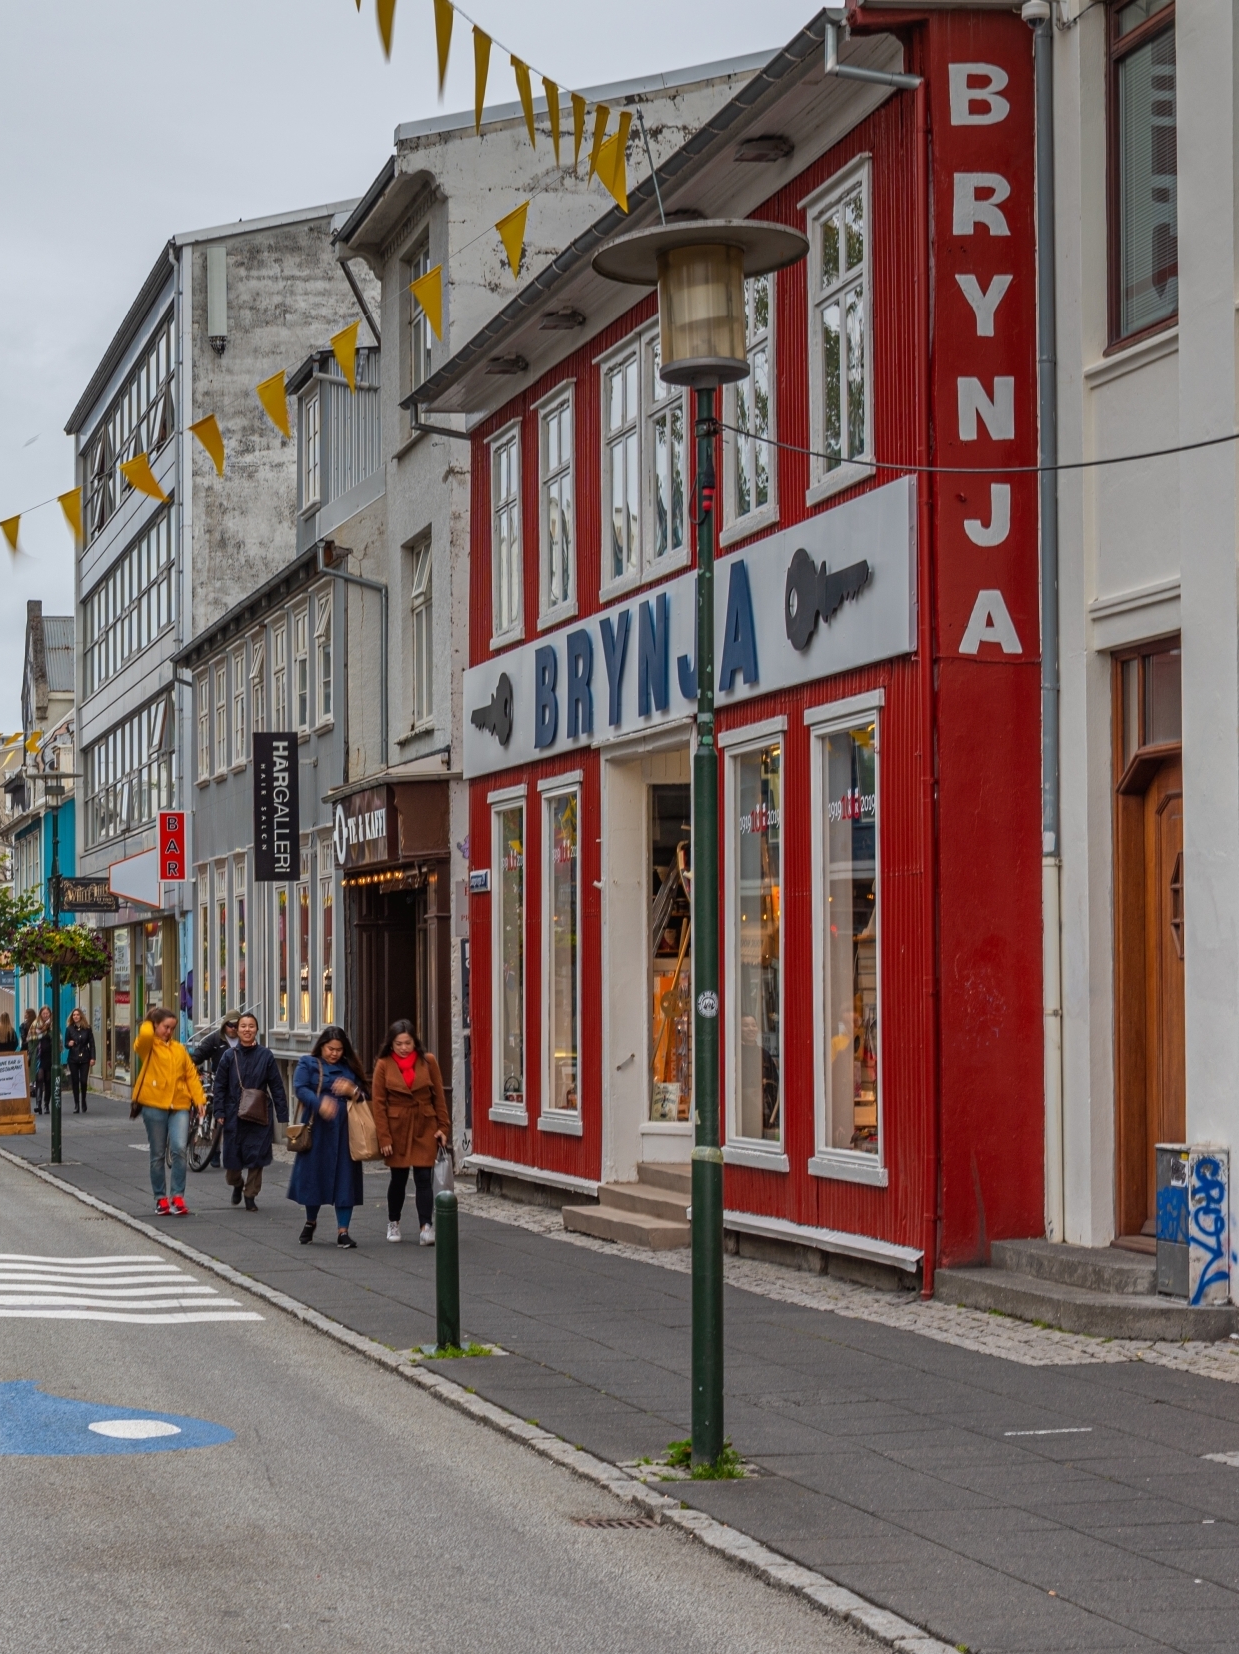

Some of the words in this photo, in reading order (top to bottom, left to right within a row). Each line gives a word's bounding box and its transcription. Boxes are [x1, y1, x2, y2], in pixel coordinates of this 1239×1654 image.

[948, 61, 1024, 655] BRYNJA
[533, 558, 759, 750] BRYNJA
[358, 814, 364, 843] &
[364, 808, 387, 841] KAFFI
[860, 793, 876, 816] 2019
[165, 815, 180, 877] BAR
